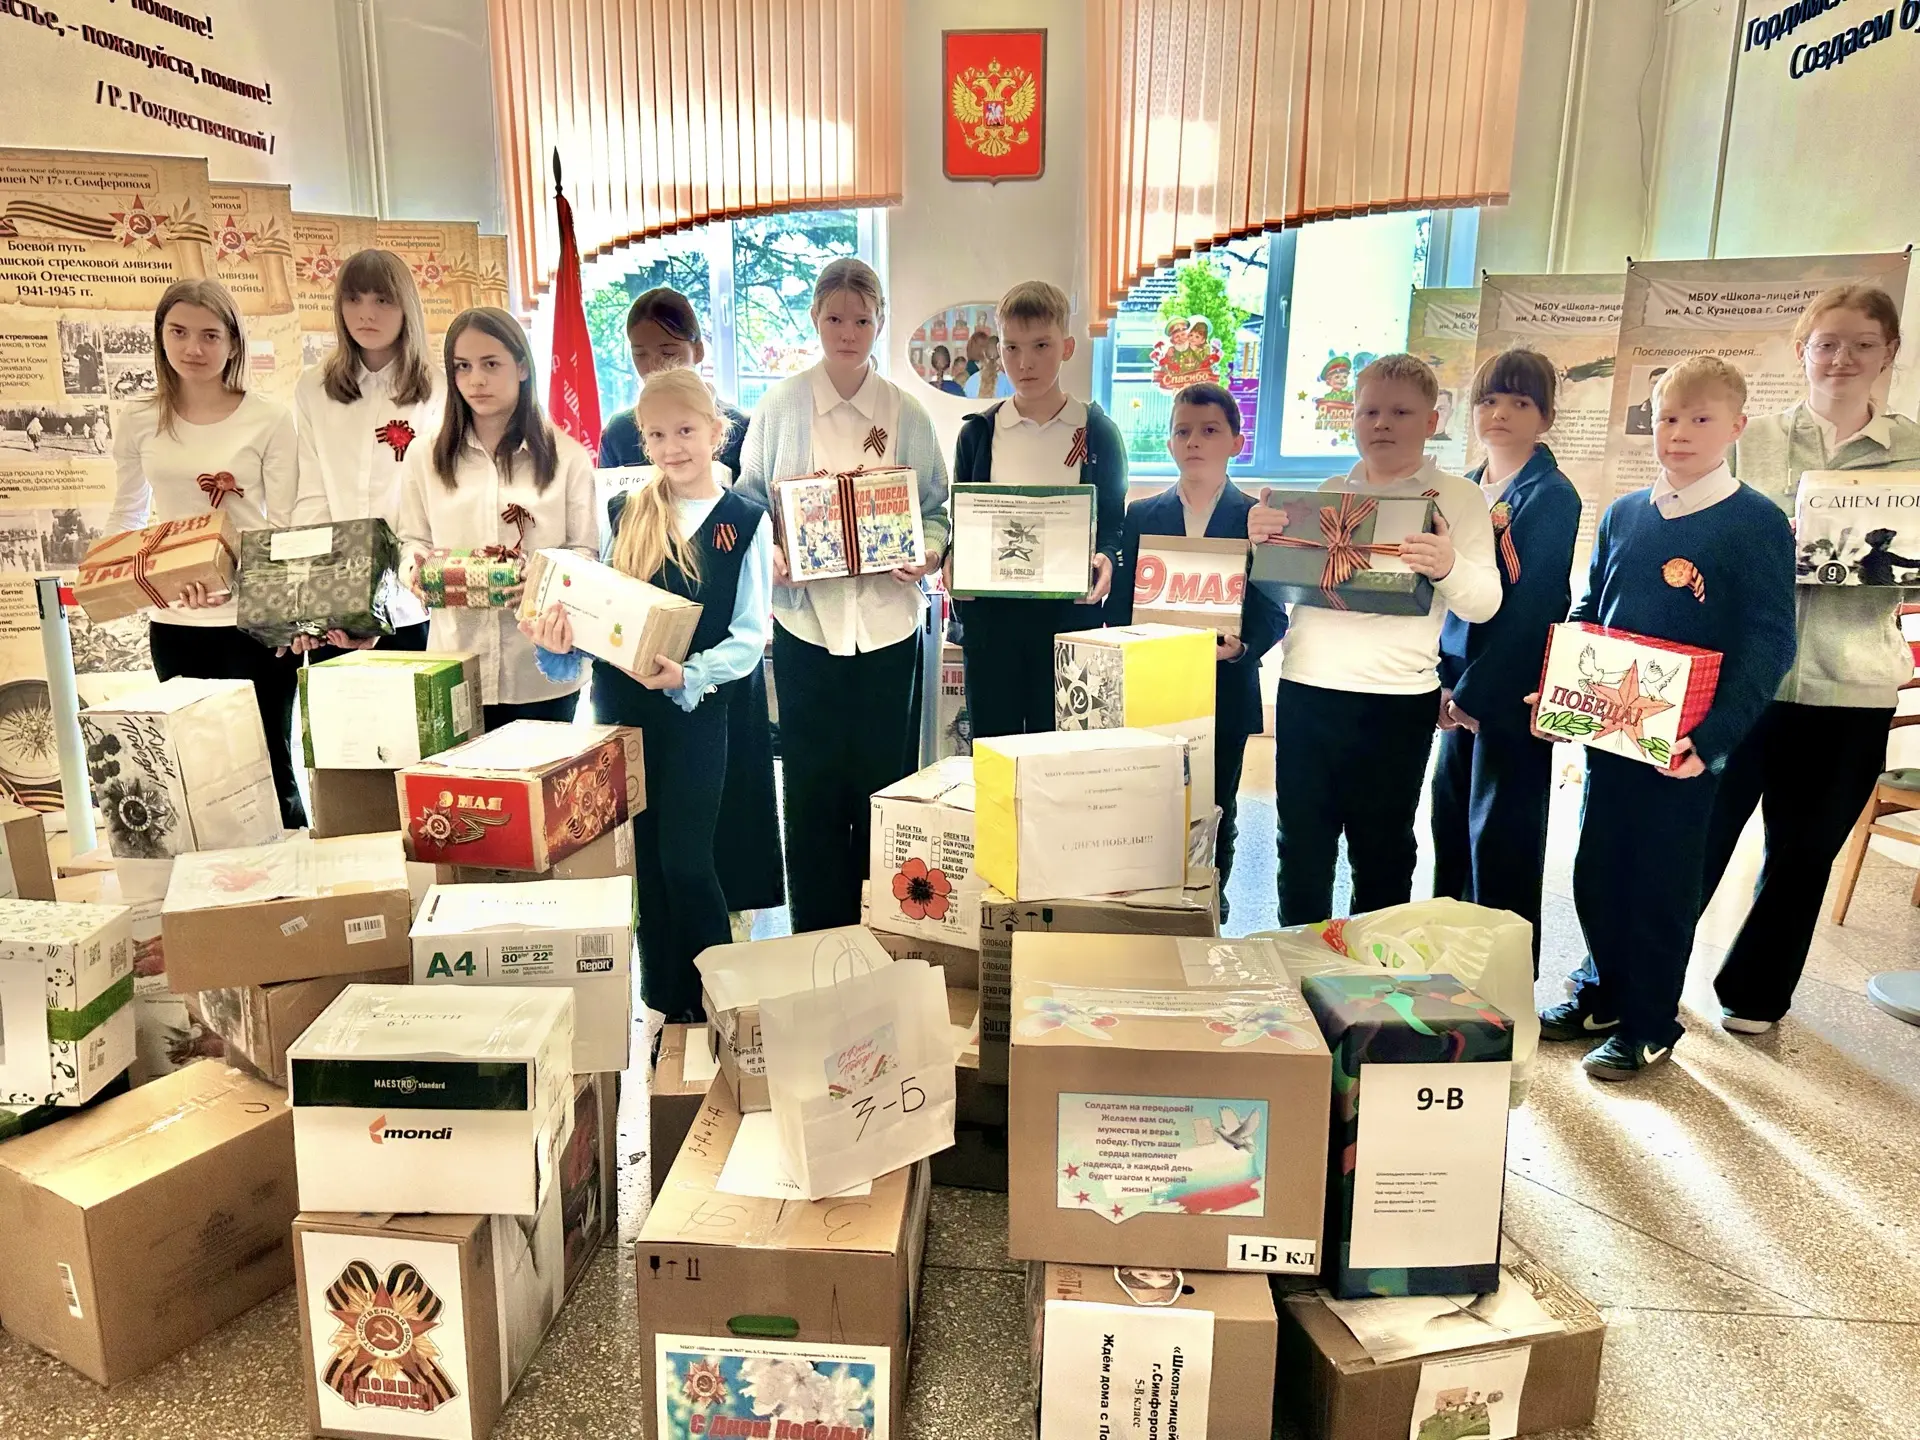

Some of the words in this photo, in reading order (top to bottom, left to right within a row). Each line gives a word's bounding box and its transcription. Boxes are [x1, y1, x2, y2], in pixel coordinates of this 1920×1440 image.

[1789, 9, 1895, 79] Создаем
[82, 23, 200, 84] пожалуйста,
[201, 67, 273, 105] помните!
[73, 177, 151, 190] Симферополя
[8, 240, 54, 252] Боевой
[58, 244, 86, 255] путь
[48, 258, 119, 270] стрелковой
[122, 261, 173, 270] дивизии
[40, 271, 136, 283] Отечественной
[16, 285, 76, 297] 1941-1945
[80, 288, 94, 297] гг.
[231, 285, 264, 293] войны
[1688, 292, 1718, 302] МБОУ
[1720, 290, 1800, 302] «Школа-лицей
[1534, 303, 1560, 311] МБОУ
[1665, 308, 1681, 316] им.
[1707, 306, 1763, 318] Кузнецова
[1550, 314, 1597, 323] Кузнецова
[1632, 346, 1716, 357] Послевоенное
[1718, 347, 1763, 358] время...
[1162, 370, 1209, 386] Спасибо
[874, 484, 908, 499] ПОБЕДА
[876, 500, 909, 515] НАРОДА
[1809, 496, 1823, 508] С
[1828, 496, 1880, 508] ДНЕМ
[1828, 566, 1837, 580] 9
[1134, 555, 1167, 604] 9
[1166, 573, 1247, 605] МАЯ
[1549, 685, 1643, 726] ПОБЕДА!
[438, 791, 454, 808] 9
[457, 794, 503, 811] МАЯ
[896, 824, 912, 832] BLACK
[896, 831, 912, 839] SUPER
[943, 832, 960, 840] GREEN
[426, 951, 477, 979] A4
[580, 959, 611, 972] Report
[374, 1079, 412, 1088] MAESTRO
[1085, 1101, 1128, 1111] Солдатам
[1142, 1104, 1194, 1114] передовой!
[1101, 1114, 1137, 1123] Желаем
[1158, 1117, 1176, 1125] сил,
[383, 1127, 453, 1140] mondi
[1098, 1127, 1139, 1136] мужества
[1149, 1129, 1173, 1137] веры
[1096, 1138, 1129, 1147] победу.
[1131, 1139, 1155, 1148] Пусть
[1099, 1150, 1130, 1159] сердца
[1131, 1152, 1177, 1160] наполняет
[1083, 1160, 1124, 1170] надежда,
[1133, 1163, 1170, 1172] каждый
[1171, 1165, 1193, 1173] день
[1088, 1172, 1113, 1182] будет
[1114, 1174, 1143, 1182] шагом
[1152, 1175, 1187, 1185] мирной
[1121, 1186, 1153, 1194] жизни!
[1238, 1243, 1277, 1263] 1-Б
[1286, 1252, 1315, 1267] кл
[356, 1307, 407, 1353] ОТЕЧЕСТВЕННАЯ
[1102, 1333, 1115, 1373] Ждём
[1100, 1376, 1111, 1411] дома
[1168, 1345, 1184, 1440] «Школа-лицей
[1100, 1412, 1108, 1420] с
[1133, 1398, 1142, 1428] класс
[690, 1413, 706, 1435] С
